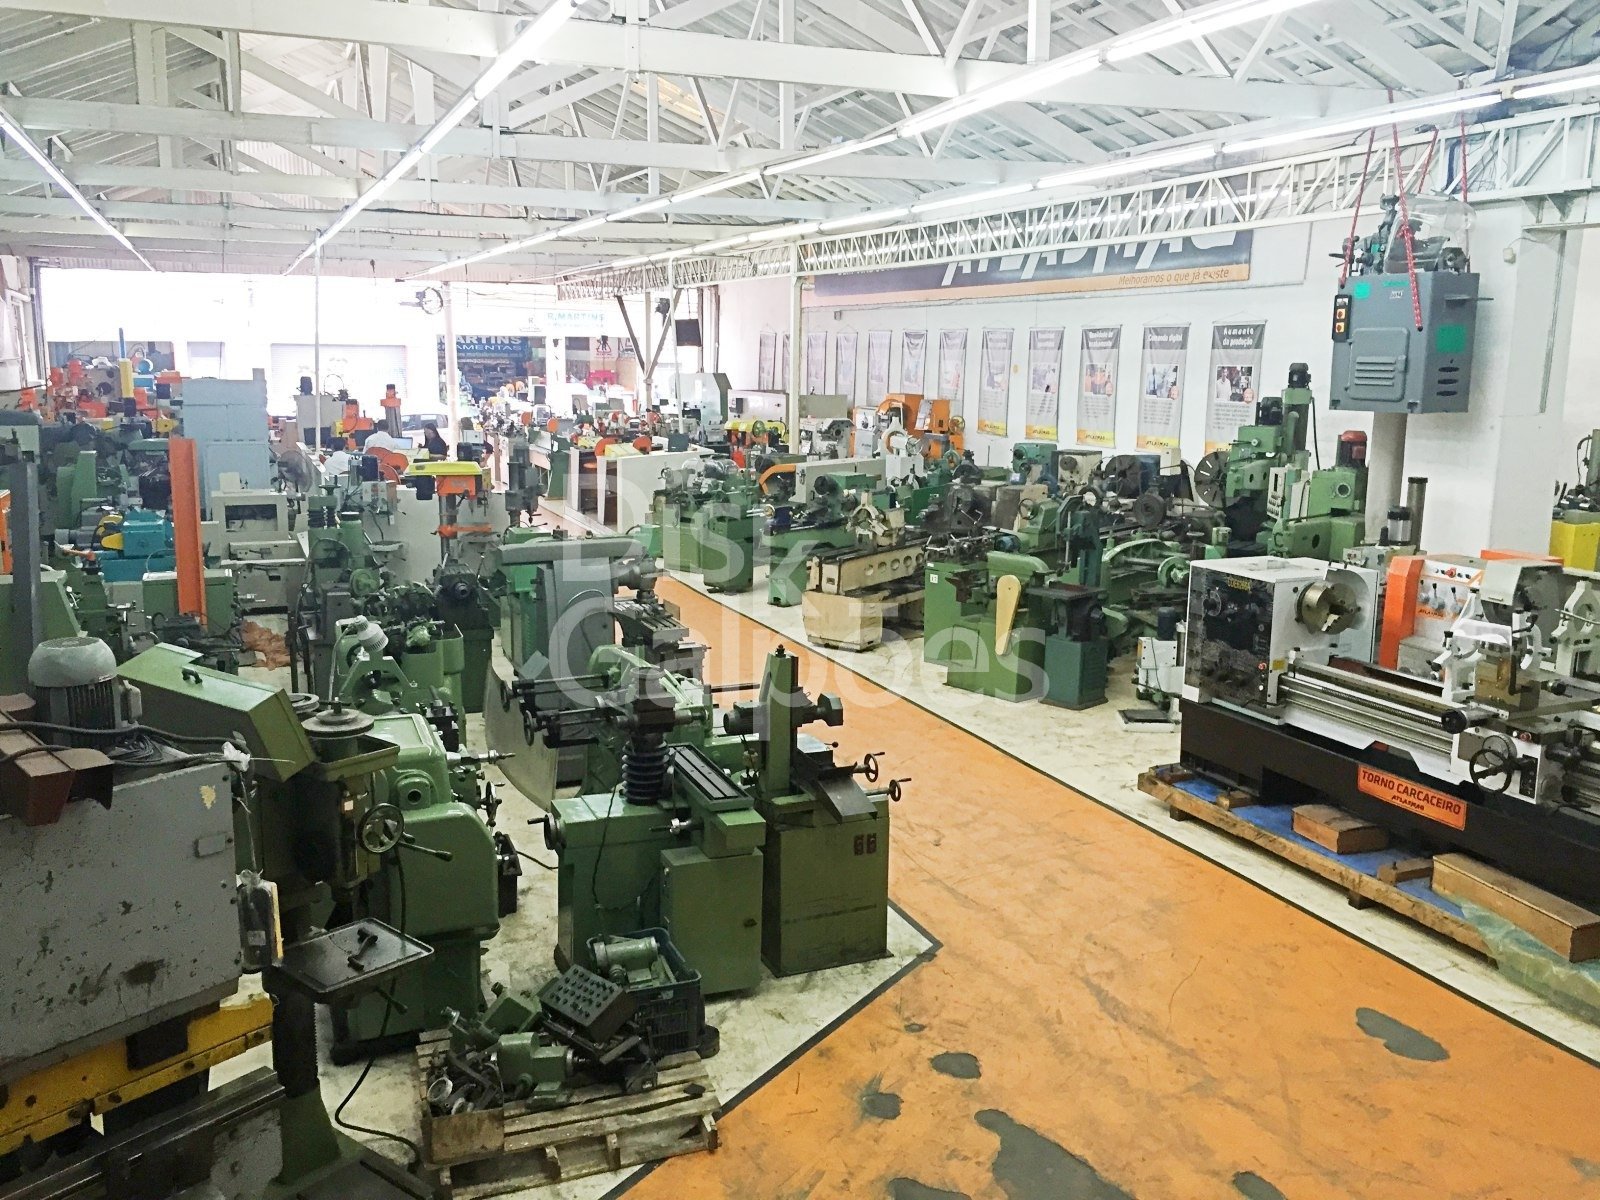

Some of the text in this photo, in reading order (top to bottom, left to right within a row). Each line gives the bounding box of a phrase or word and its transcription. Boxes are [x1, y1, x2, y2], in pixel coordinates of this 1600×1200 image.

[1118, 273, 1165, 286] Melhoramos
[1174, 272, 1190, 284] que
[1192, 269, 1201, 284] já
[1202, 267, 1230, 279] existe
[1223, 327, 1254, 336] Aumento
[1168, 333, 1183, 344] digital
[1222, 337, 1254, 348] da produção
[1361, 769, 1462, 815] TORNO CARCACEIRO
